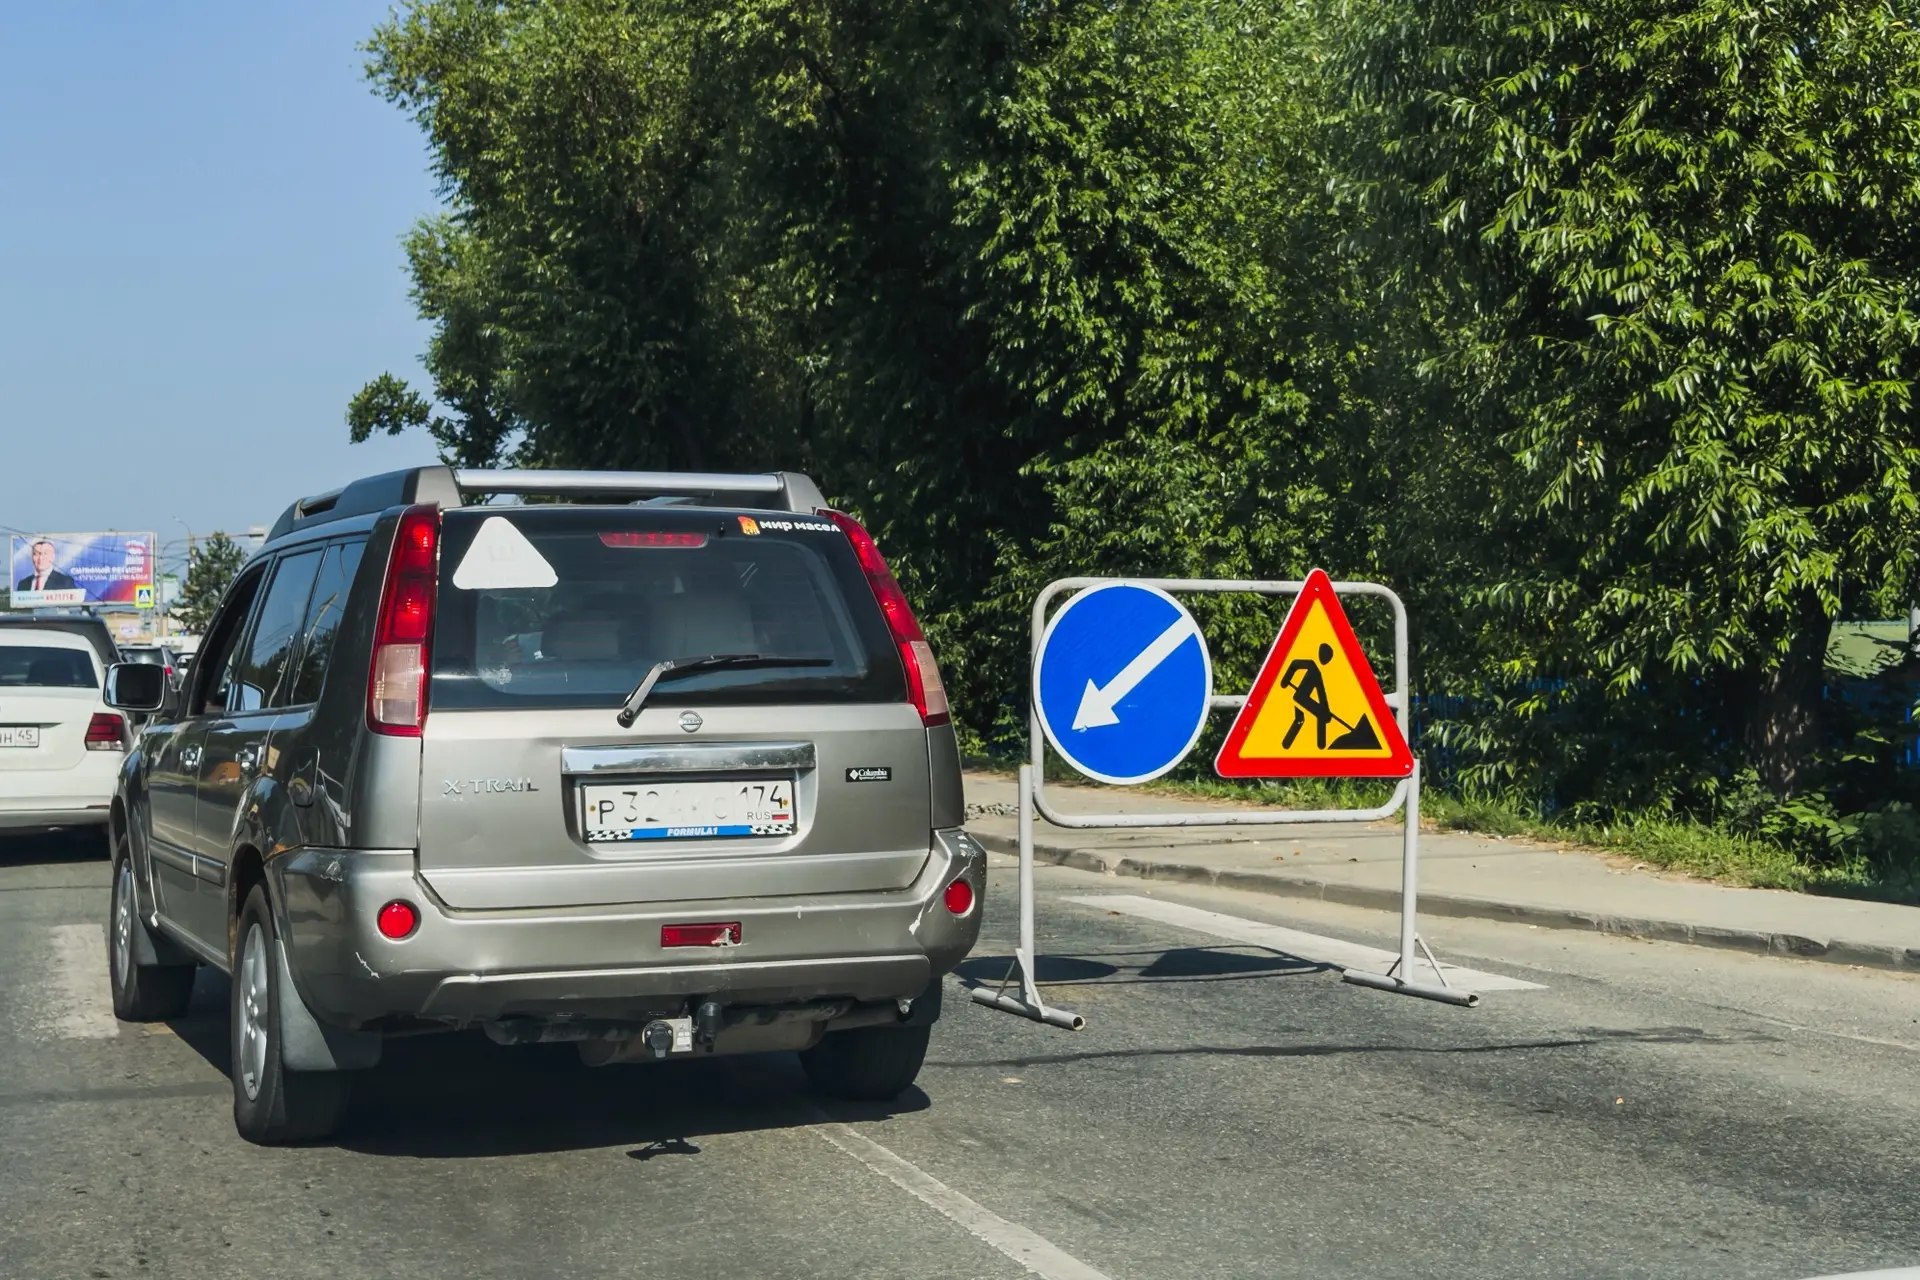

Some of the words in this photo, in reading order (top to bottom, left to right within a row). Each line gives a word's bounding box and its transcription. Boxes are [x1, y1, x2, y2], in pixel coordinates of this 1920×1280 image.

[759, 520, 793, 531] мир
[794, 522, 841, 532] масел
[18, 729, 33, 740] 45
[443, 777, 540, 796] X-TRAIL
[739, 785, 784, 811] 174
[746, 810, 771, 821] RUS
[666, 827, 718, 837] FORMULA1
